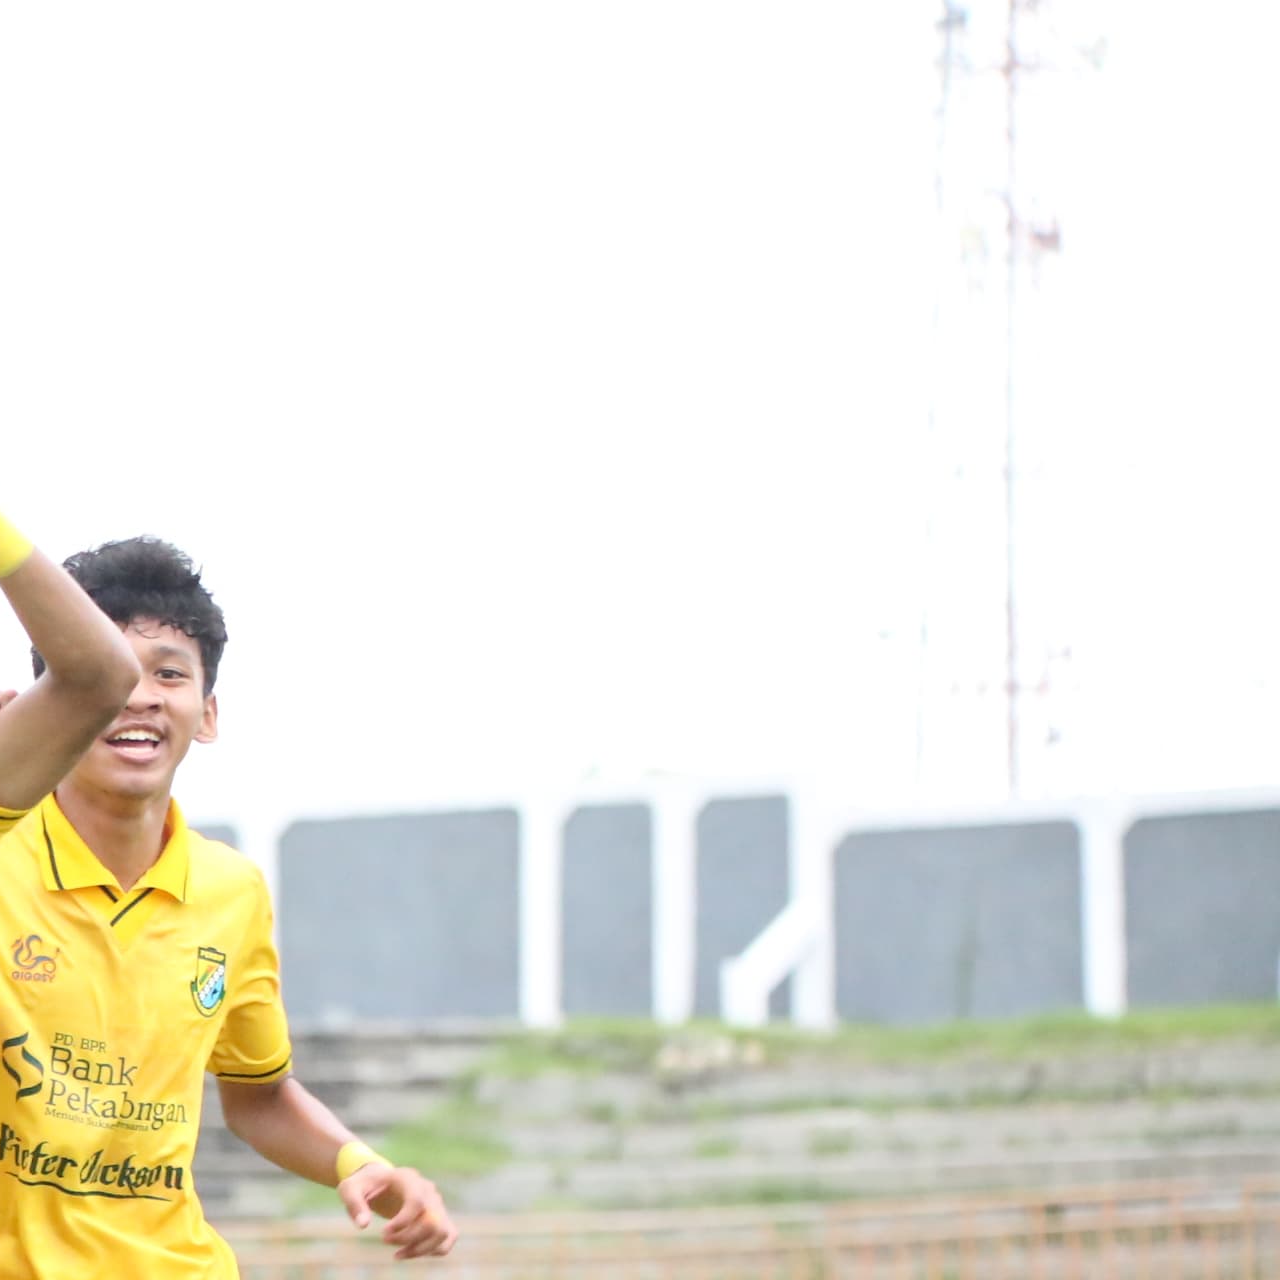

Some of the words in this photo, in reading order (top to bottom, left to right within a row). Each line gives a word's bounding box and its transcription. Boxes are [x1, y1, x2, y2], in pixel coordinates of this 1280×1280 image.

[11, 970, 55, 984] GIGGSY
[80, 1038, 107, 1053] BPR
[49, 1045, 139, 1087] Bank
[44, 1106, 85, 1124] Menuju
